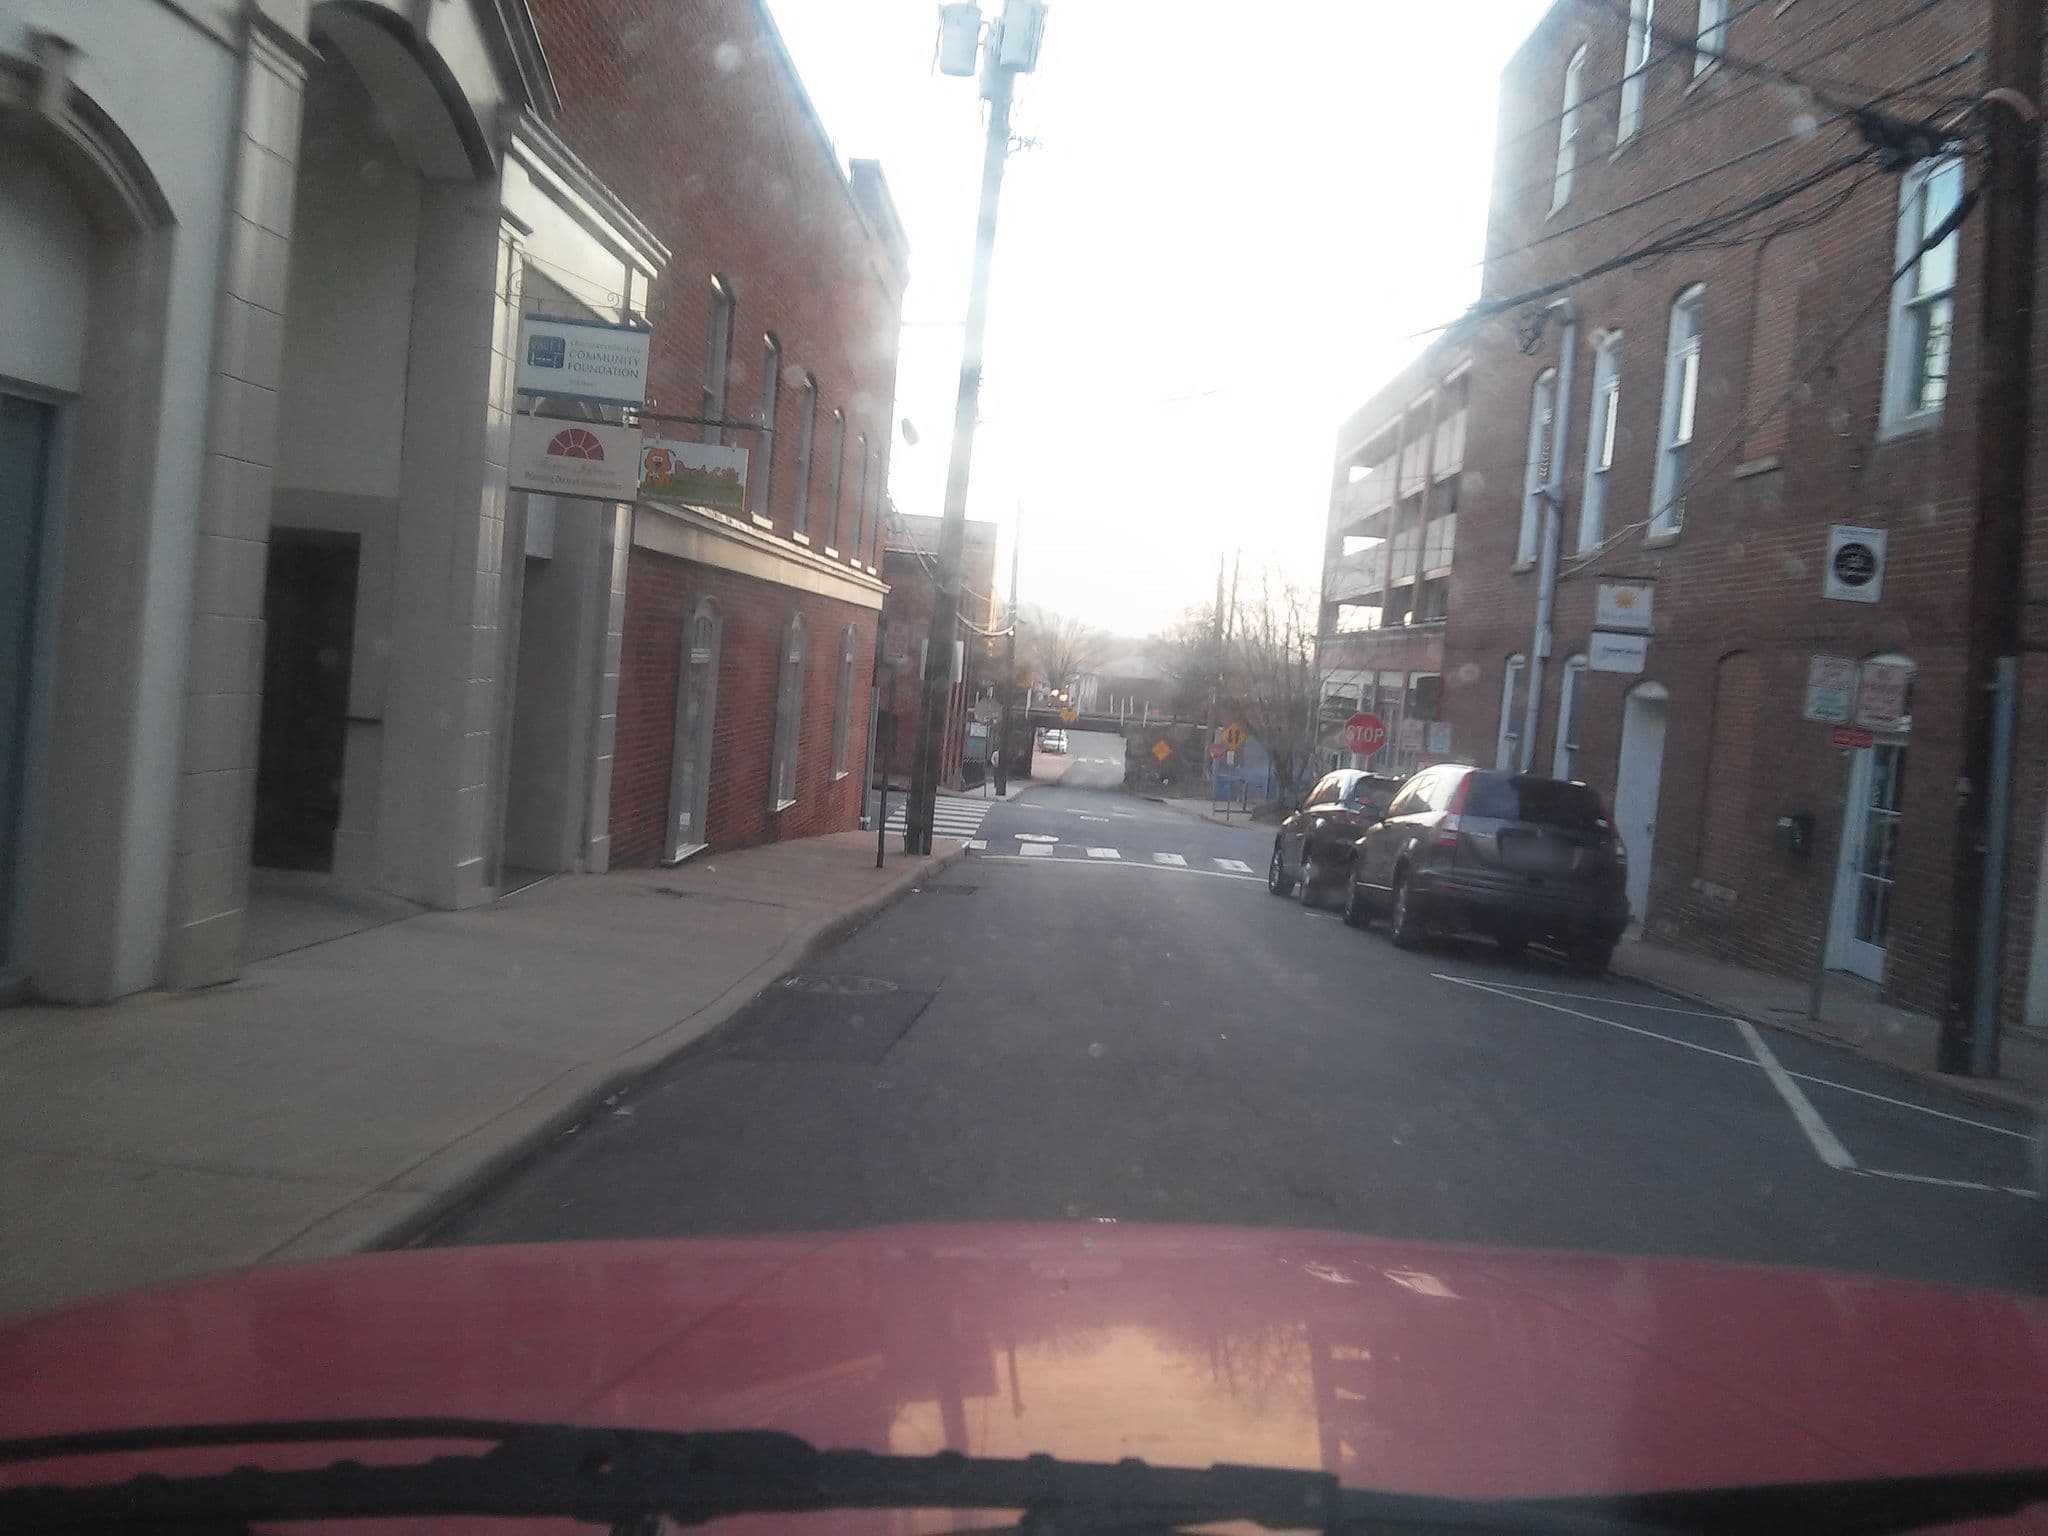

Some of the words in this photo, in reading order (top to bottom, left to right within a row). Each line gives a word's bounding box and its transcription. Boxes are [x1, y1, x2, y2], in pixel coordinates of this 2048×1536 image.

[569, 349, 641, 367] COMMUNITY
[567, 362, 640, 379] FOUNDATION
[1345, 725, 1385, 743] STOP
